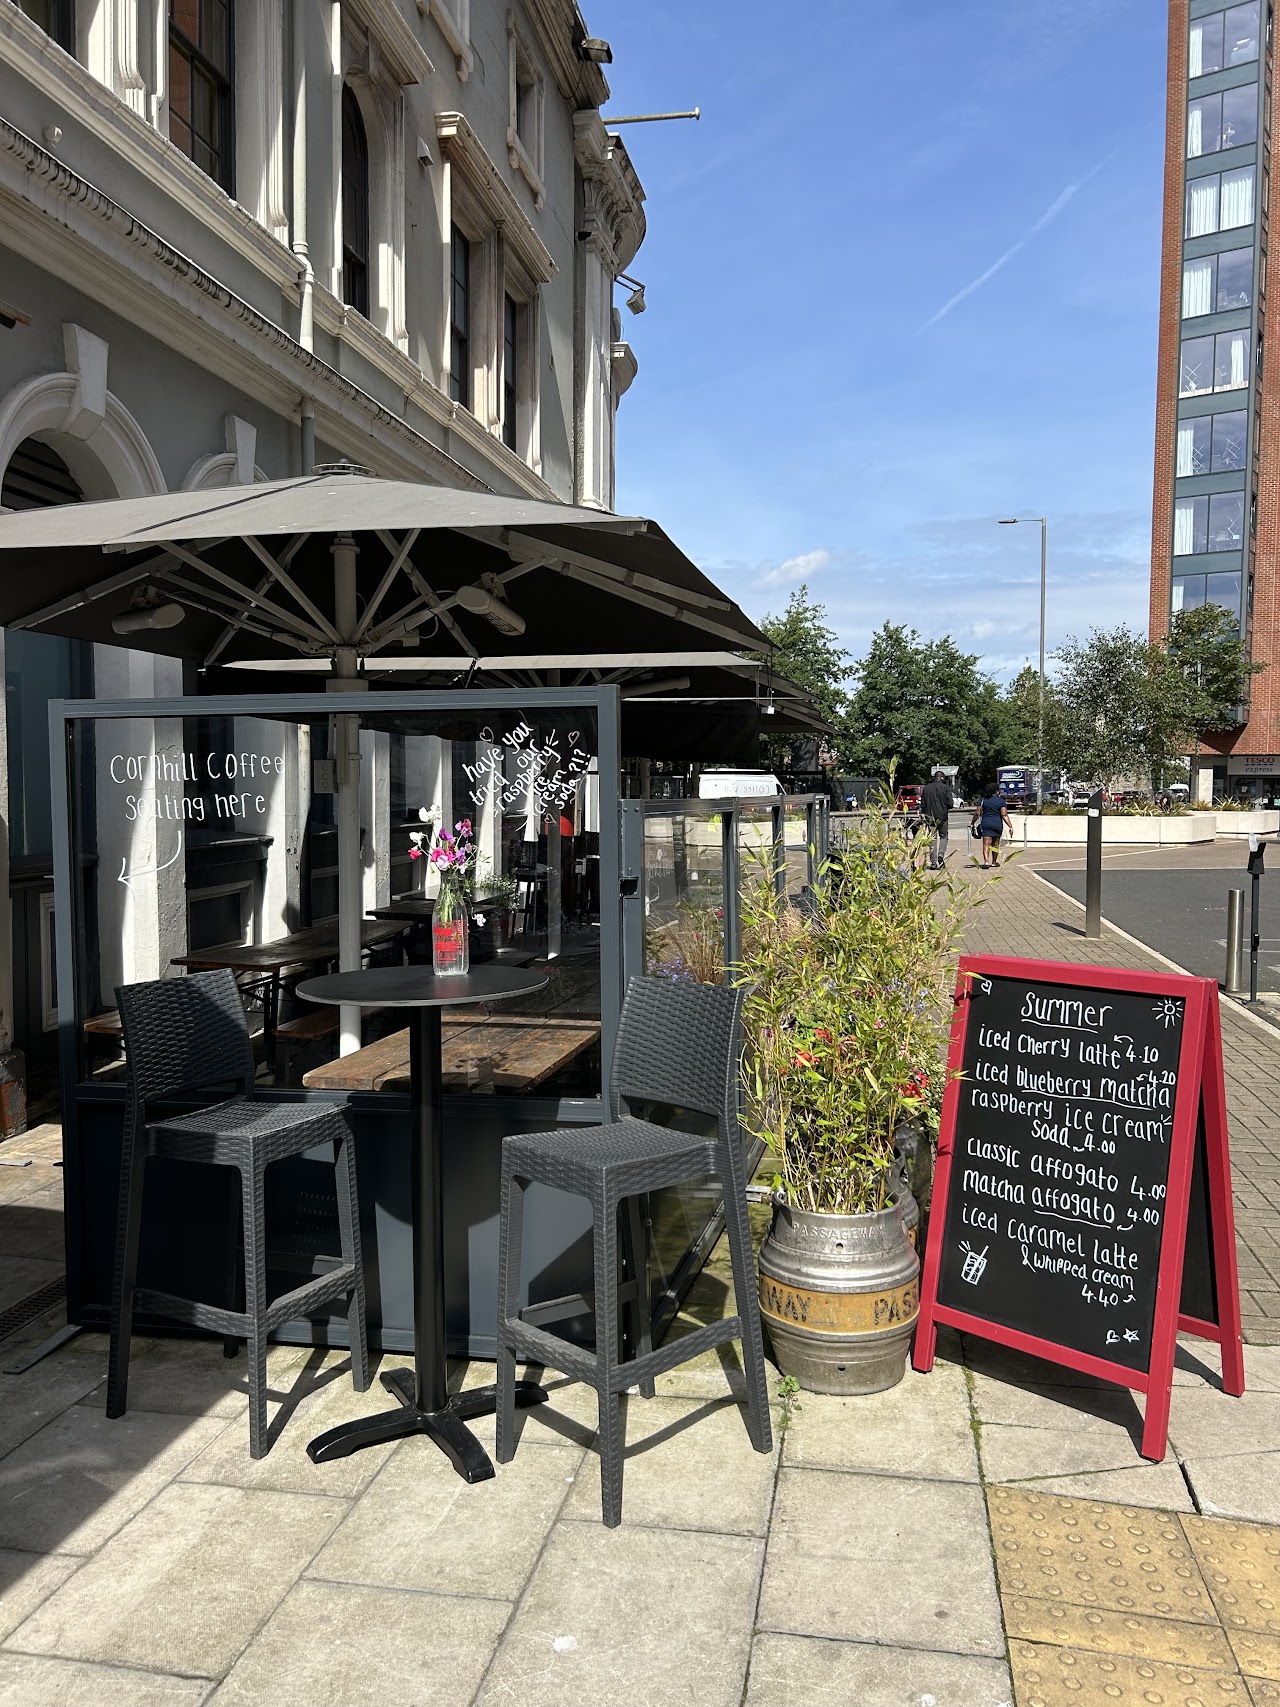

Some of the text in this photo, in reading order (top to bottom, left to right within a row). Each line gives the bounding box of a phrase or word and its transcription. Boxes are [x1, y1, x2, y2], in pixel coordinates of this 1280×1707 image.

[110, 753, 198, 784] Cornhill
[462, 722, 534, 782] have you
[469, 739, 540, 806] tried our
[496, 746, 561, 811] raspberry
[533, 775, 550, 796] ice
[535, 769, 567, 814] cream
[555, 778, 581, 810] soda
[214, 792, 266, 818] here
[979, 1024, 1010, 1051] iced
[1079, 1041, 1121, 1070] latte
[1125, 1044, 1159, 1064] 4.10
[975, 1058, 1171, 1109] iced blueberry matcha
[1148, 1070, 1176, 1087] 4.20
[971, 1088, 1165, 1143] raspberry ice cream
[1084, 1132, 1116, 1154] 4.00
[963, 1169, 1160, 1226] matcha affogato 4.00
[1030, 1154, 1119, 1192] affogato
[1130, 1175, 1167, 1201] 4.00
[792, 1220, 884, 1240] PASSAGEWAY
[962, 1203, 1139, 1270] iced caramel latte
[1081, 1283, 1119, 1308] 4.40
[1092, 1268, 1134, 1291] cream
